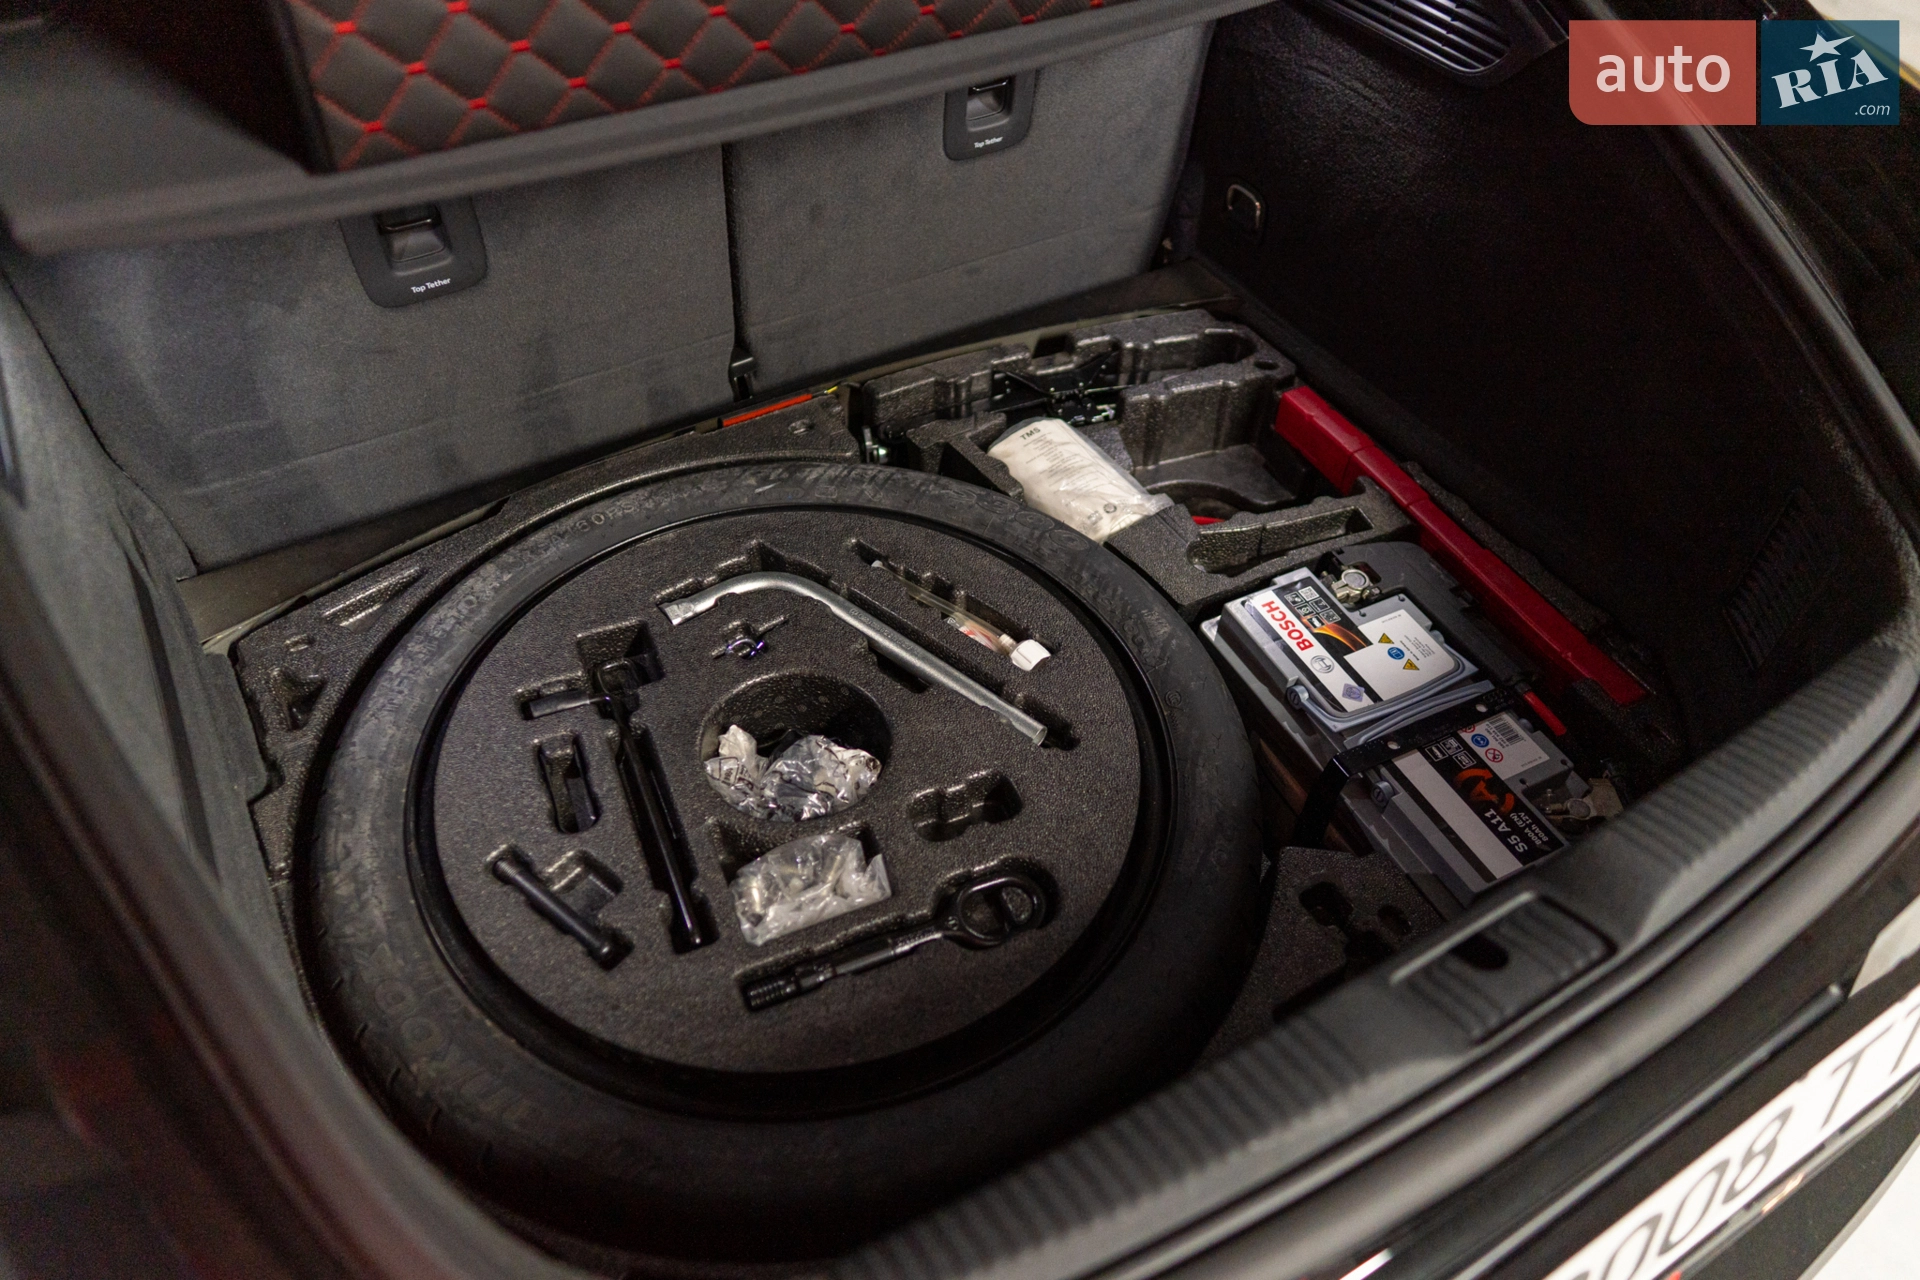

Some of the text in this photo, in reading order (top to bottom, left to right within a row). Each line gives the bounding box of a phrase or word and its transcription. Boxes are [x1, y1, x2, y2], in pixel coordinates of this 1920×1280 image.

[410, 277, 451, 294] Top Tether
[1019, 426, 1041, 441] TMS
[1261, 600, 1314, 652] BOSCH
[1484, 808, 1528, 853] S5 A11
[1509, 812, 1542, 845] 800A (EN)
[1518, 812, 1533, 824] 12V
[1568, 1105, 1795, 1280] 008
